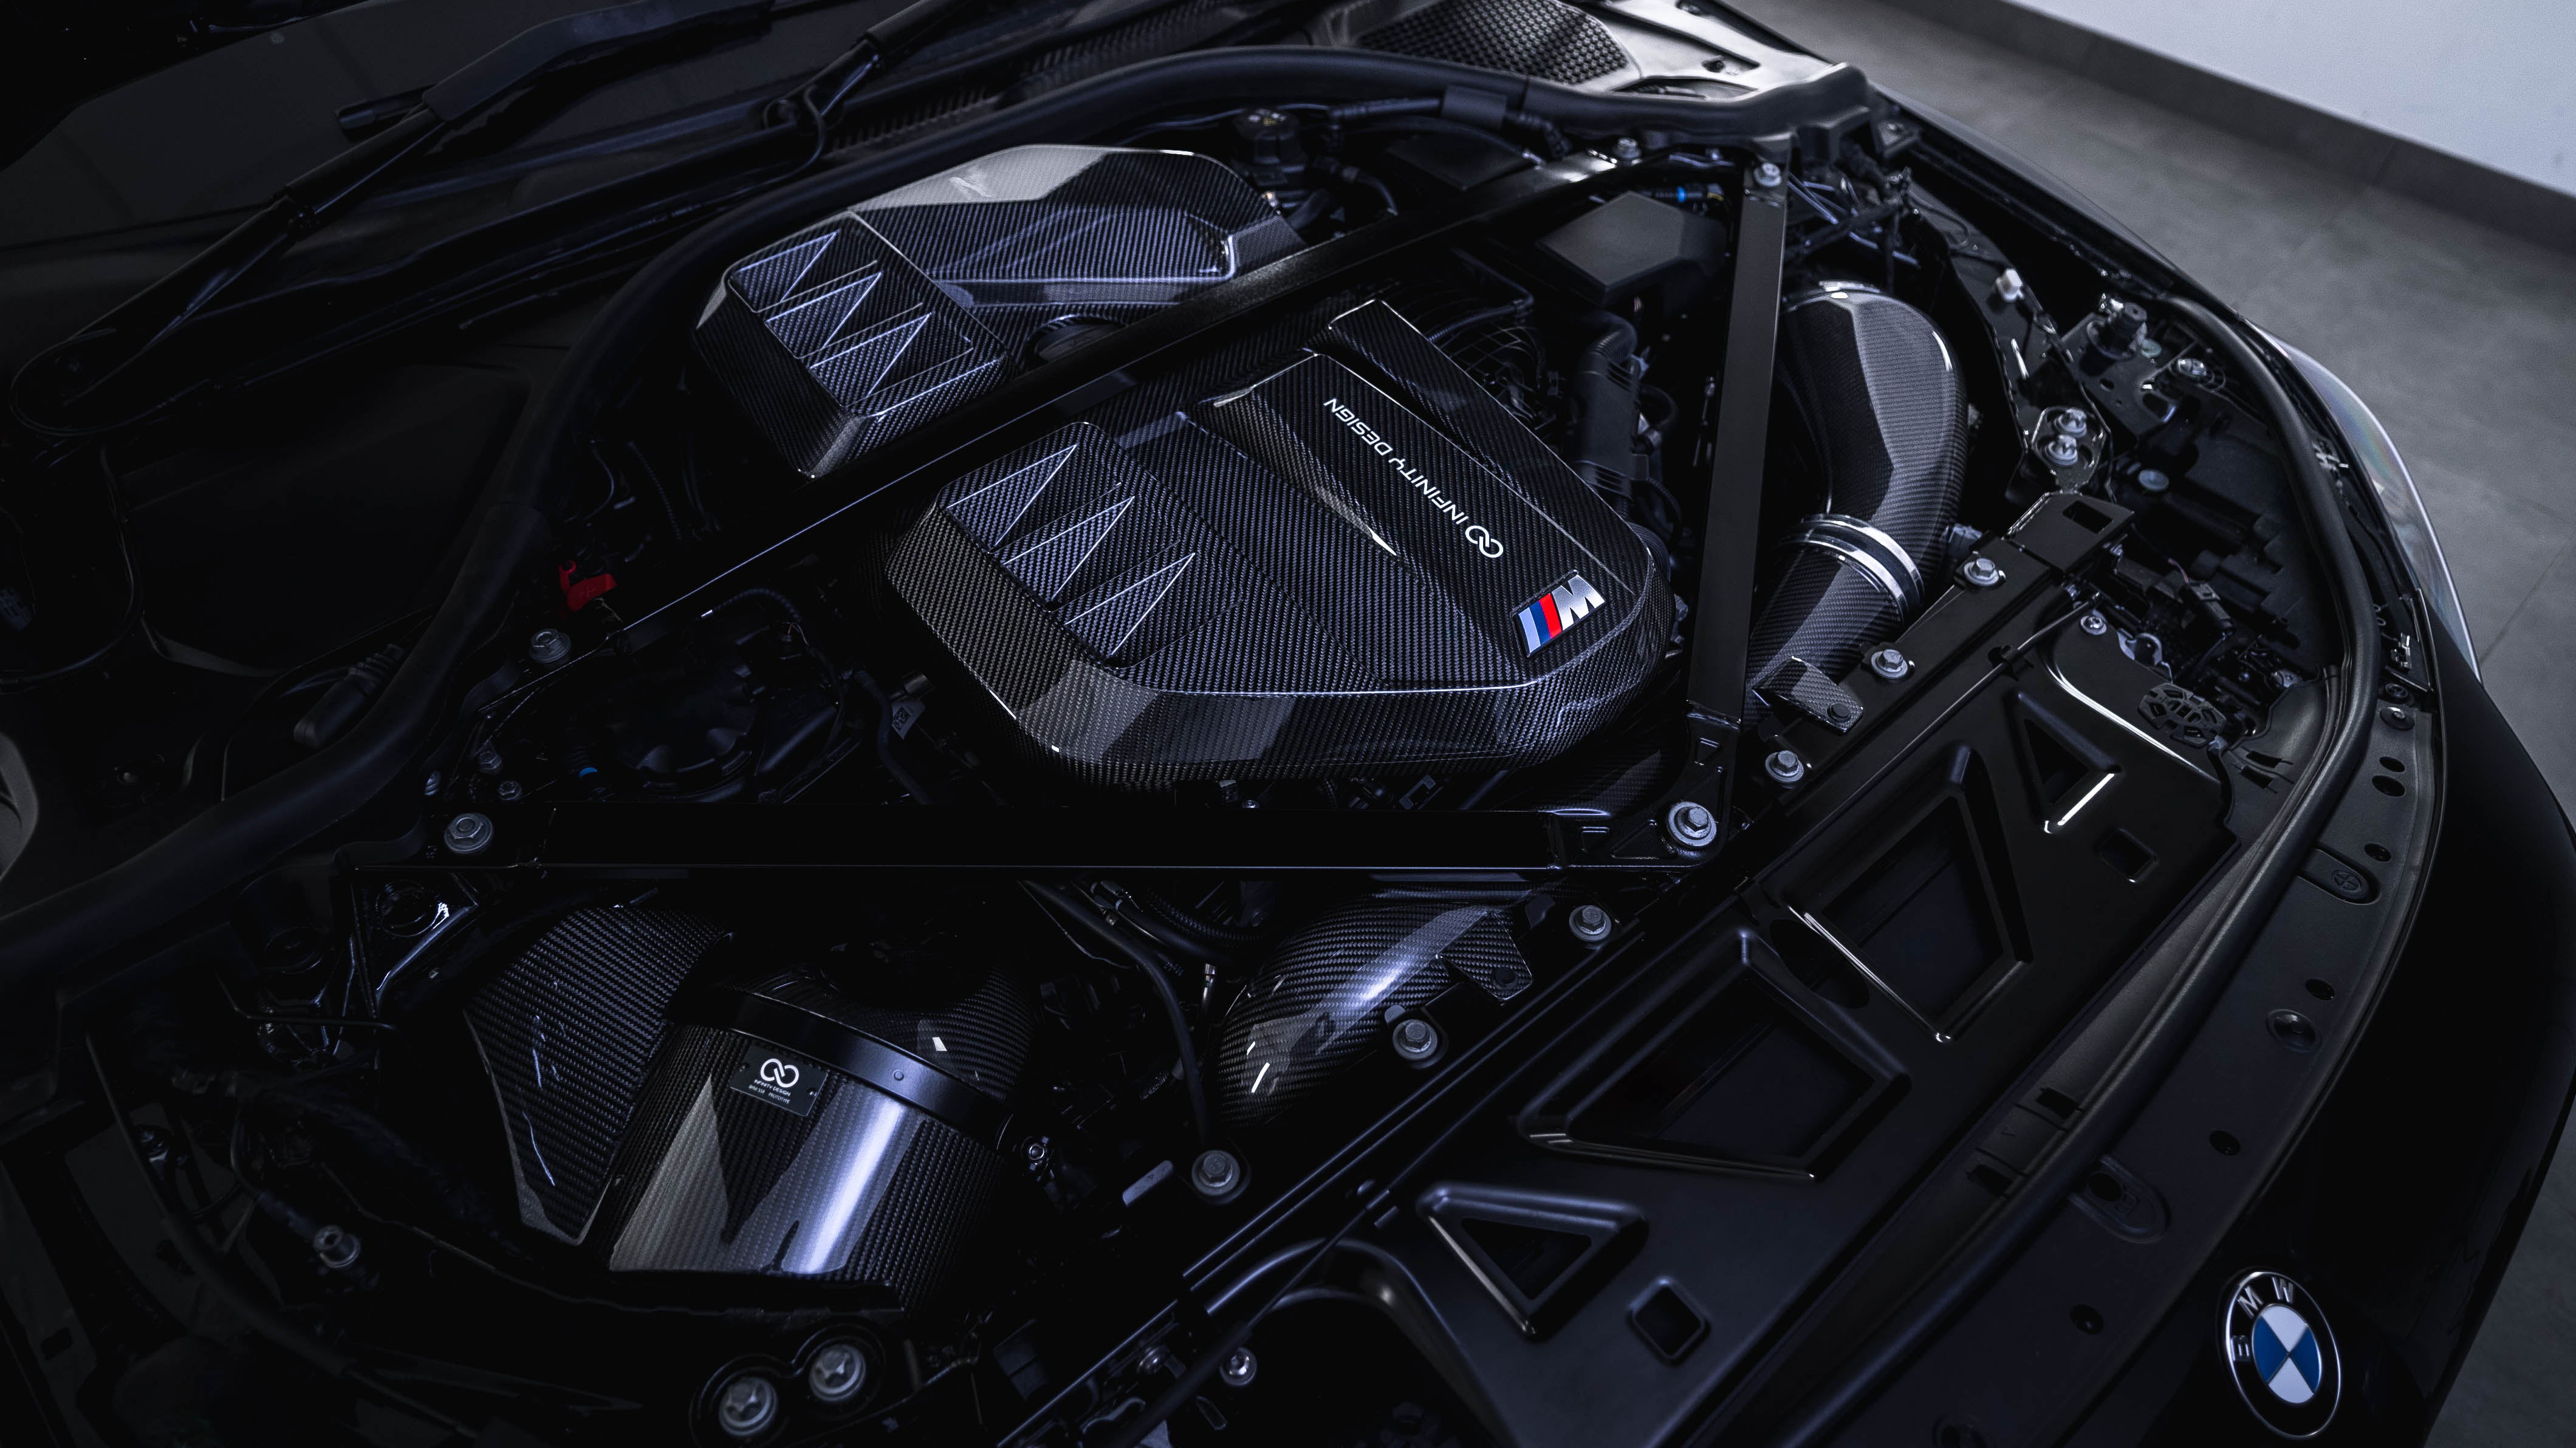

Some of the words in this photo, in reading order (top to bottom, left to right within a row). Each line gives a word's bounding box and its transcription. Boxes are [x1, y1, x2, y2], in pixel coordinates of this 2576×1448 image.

[1323, 397, 1394, 456] DESIGN
[1388, 457, 1469, 525] INFINITY
[754, 1079, 773, 1089] INFINITY
[772, 1086, 792, 1097] DESIGN
[2231, 1276, 2295, 1362] BMW
